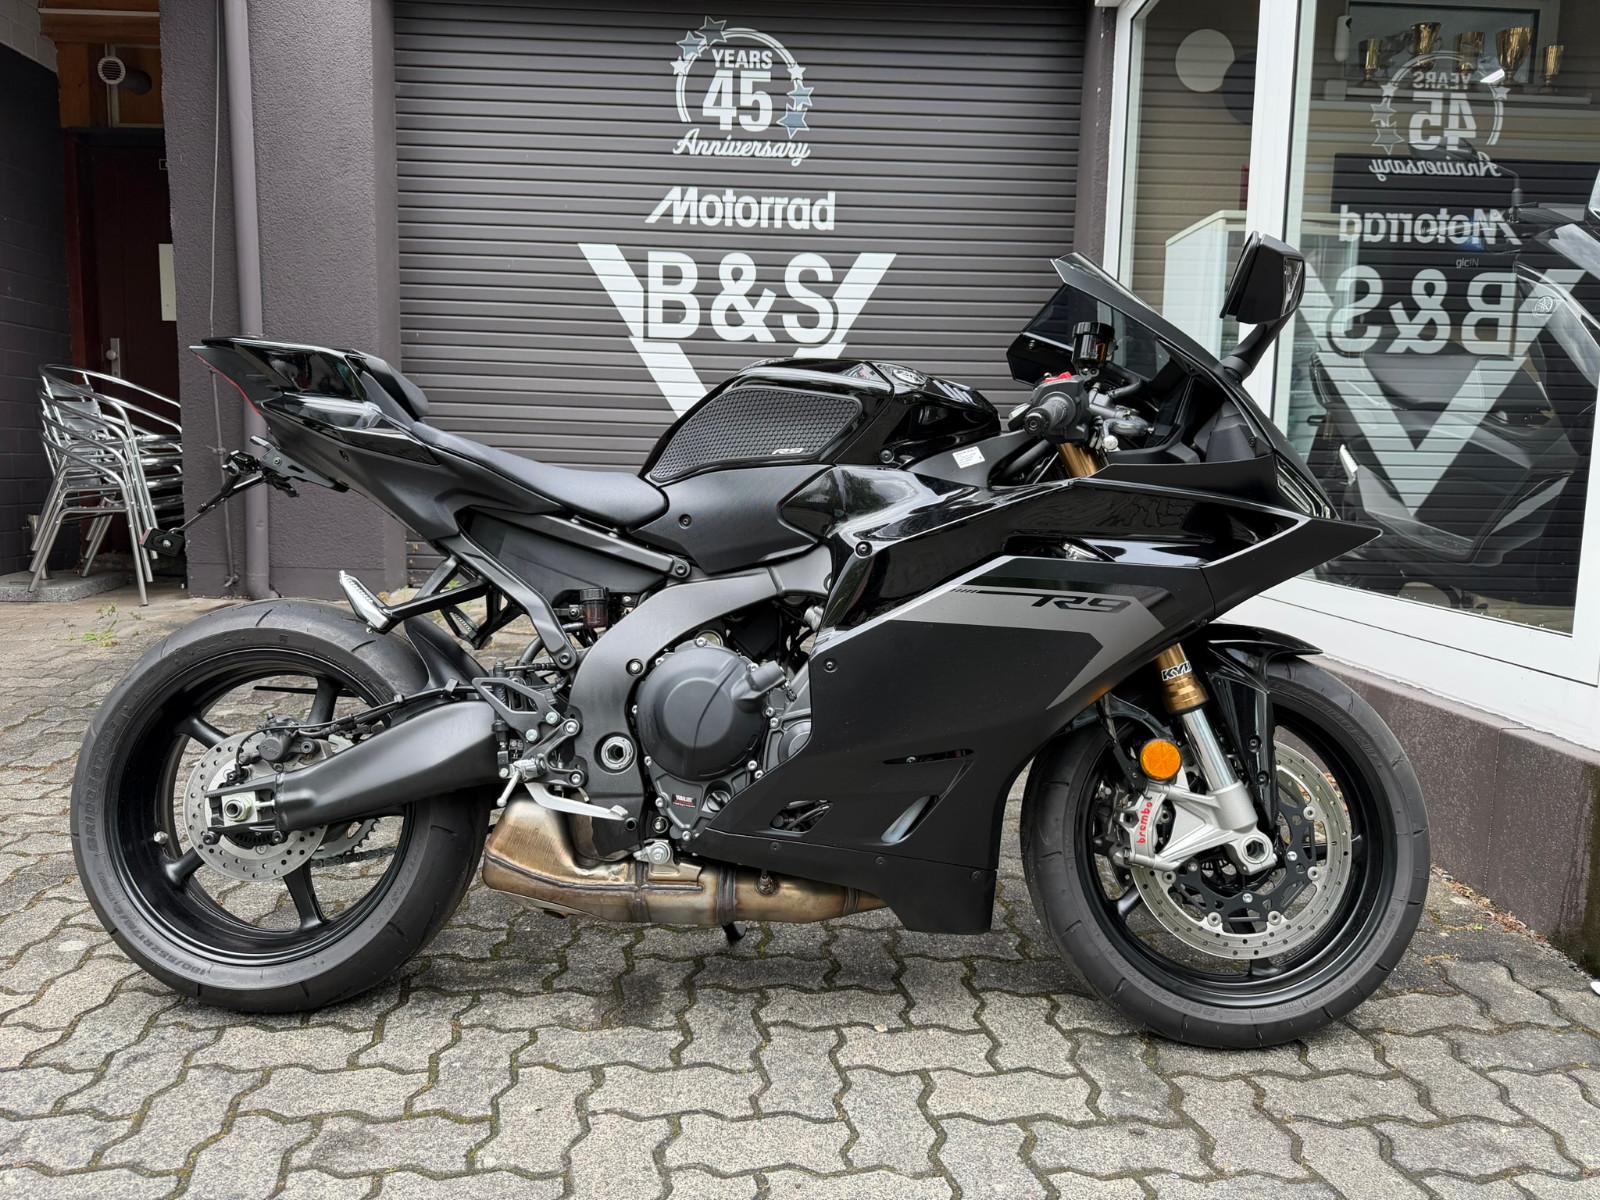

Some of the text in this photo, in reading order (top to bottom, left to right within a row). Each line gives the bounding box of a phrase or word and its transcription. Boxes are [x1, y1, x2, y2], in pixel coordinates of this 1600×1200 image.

[711, 49, 773, 69] YEARS
[702, 70, 773, 132] 45
[672, 128, 811, 166] Anniversary
[644, 186, 836, 231] Motorrad
[647, 250, 835, 344] B&S
[1031, 593, 1132, 614] R9
[1136, 801, 1153, 845] brembo
